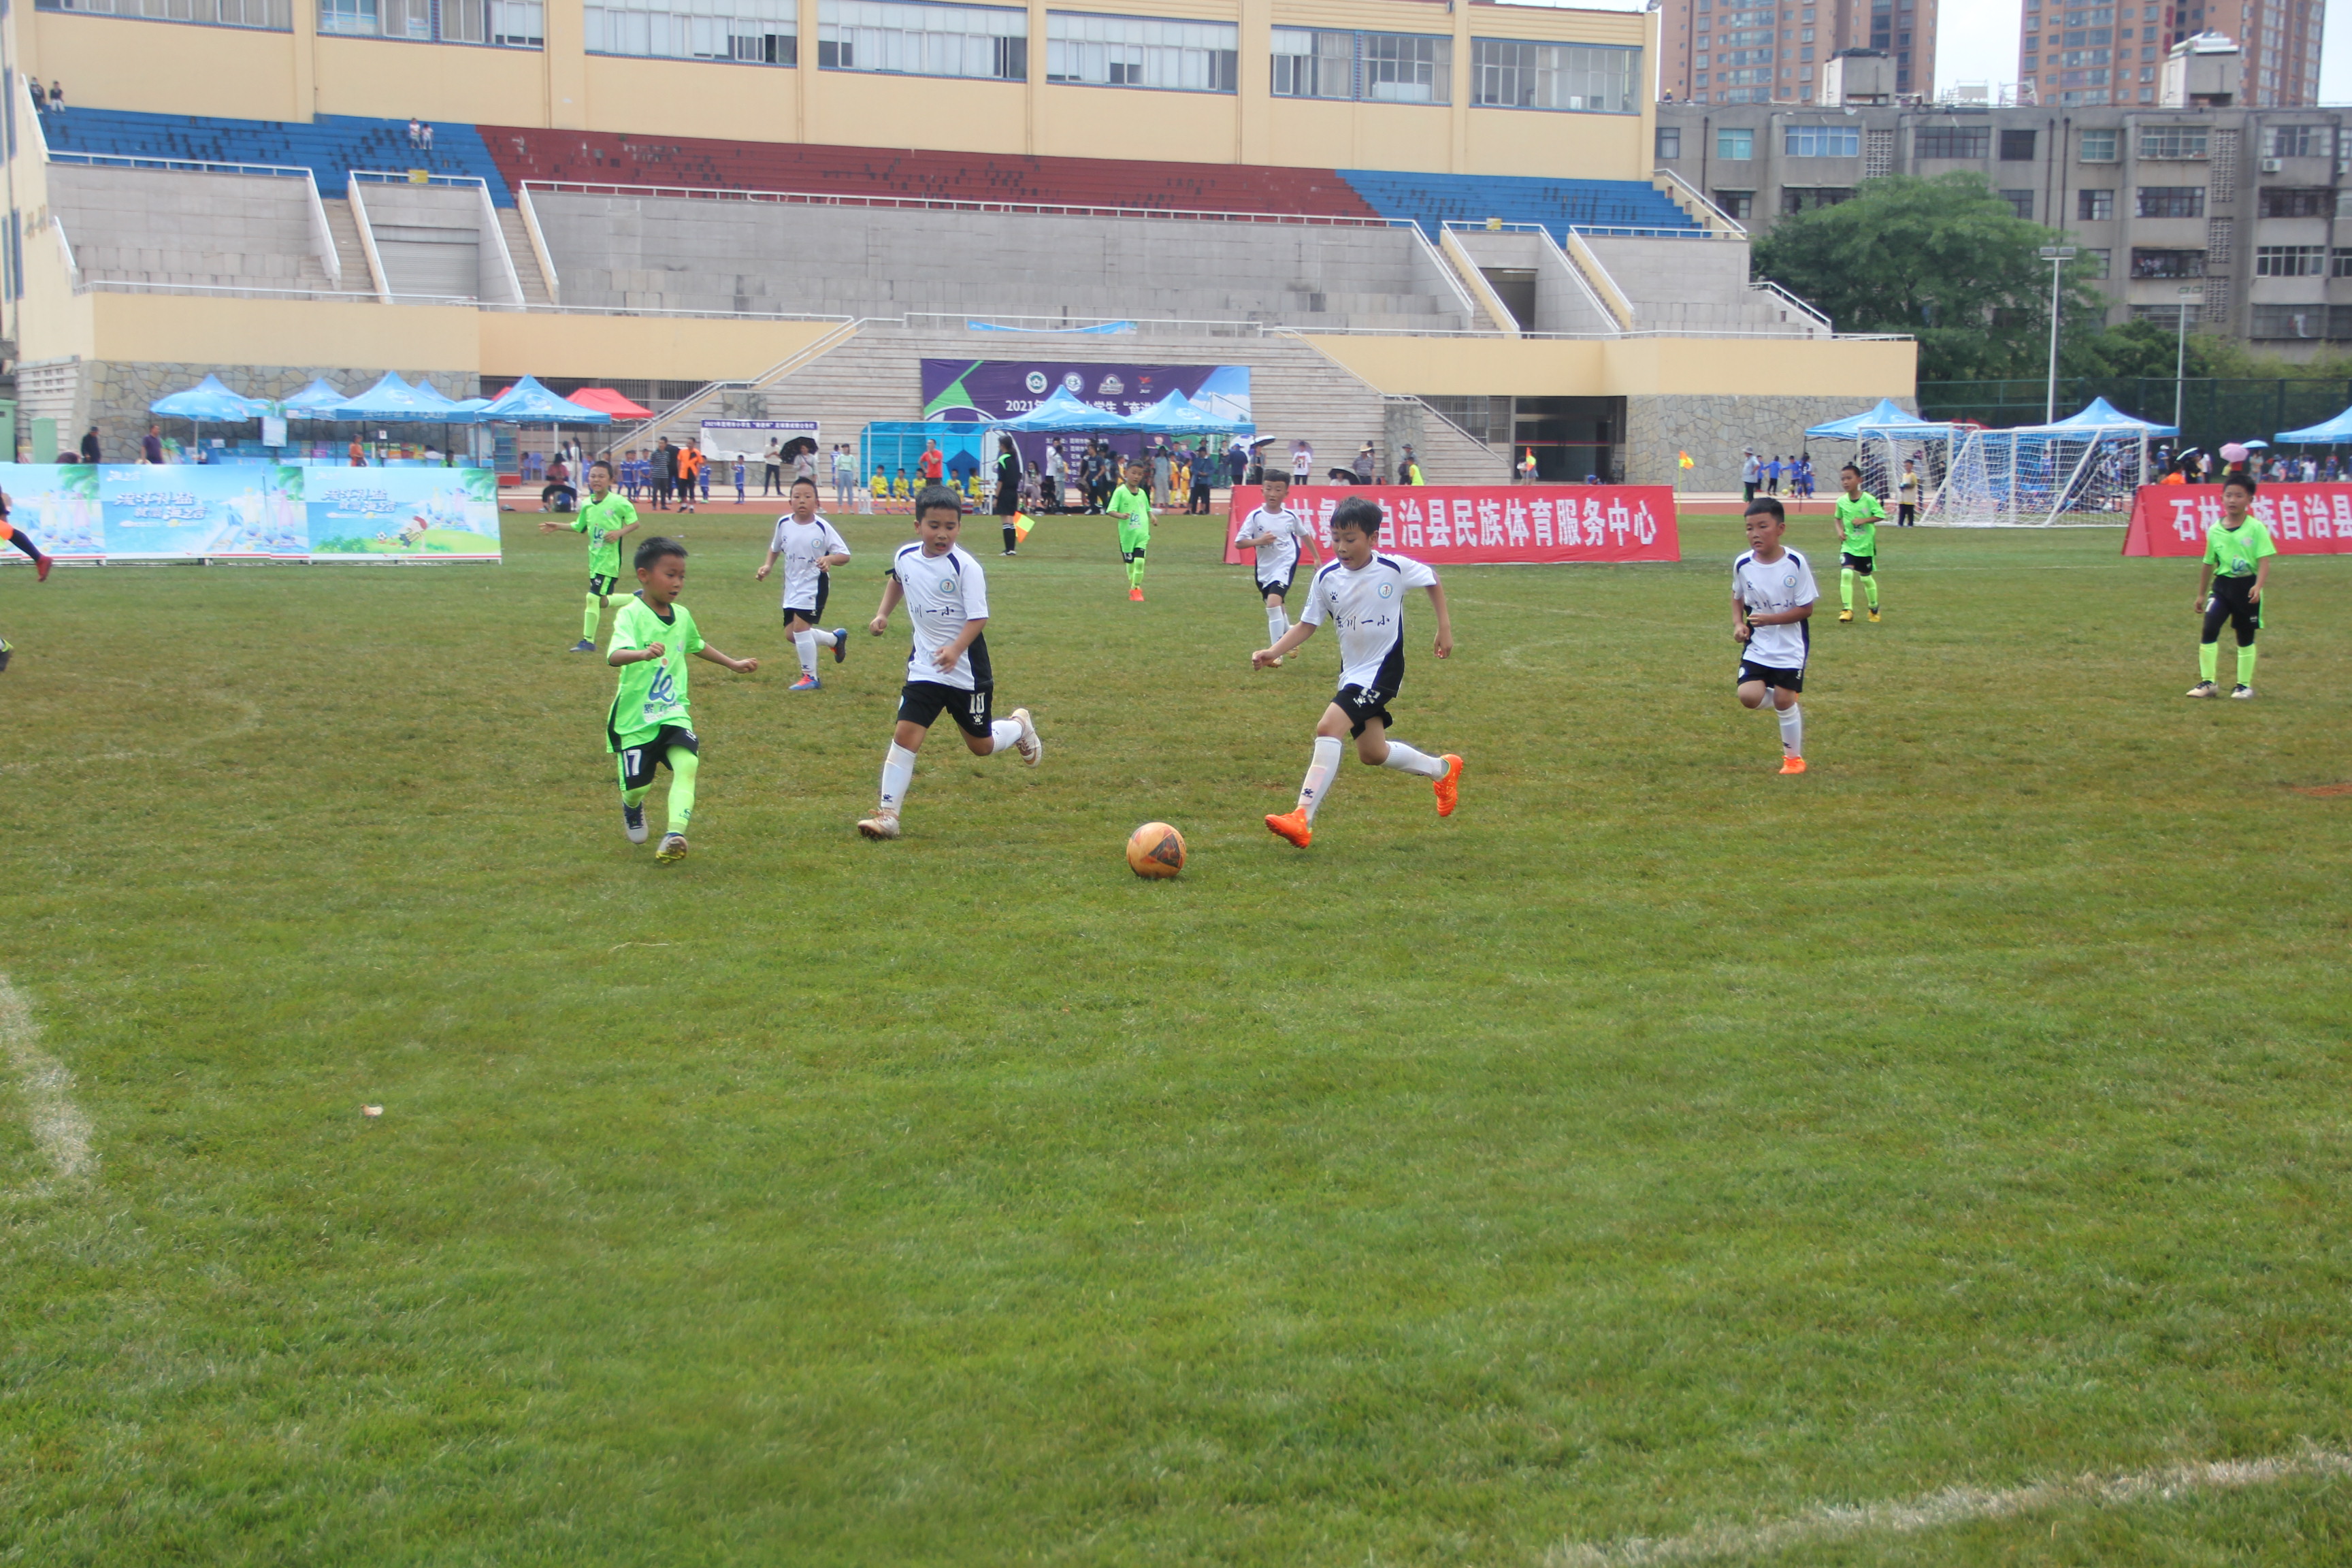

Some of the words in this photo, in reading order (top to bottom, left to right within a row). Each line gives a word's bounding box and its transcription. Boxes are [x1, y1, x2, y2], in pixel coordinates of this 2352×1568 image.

[1262, 497, 1656, 549] 林彝自治县民族体育服务中心
[2169, 494, 2352, 542] 石林族自治县
[968, 692, 985, 714] 10
[623, 749, 642, 777] 17
